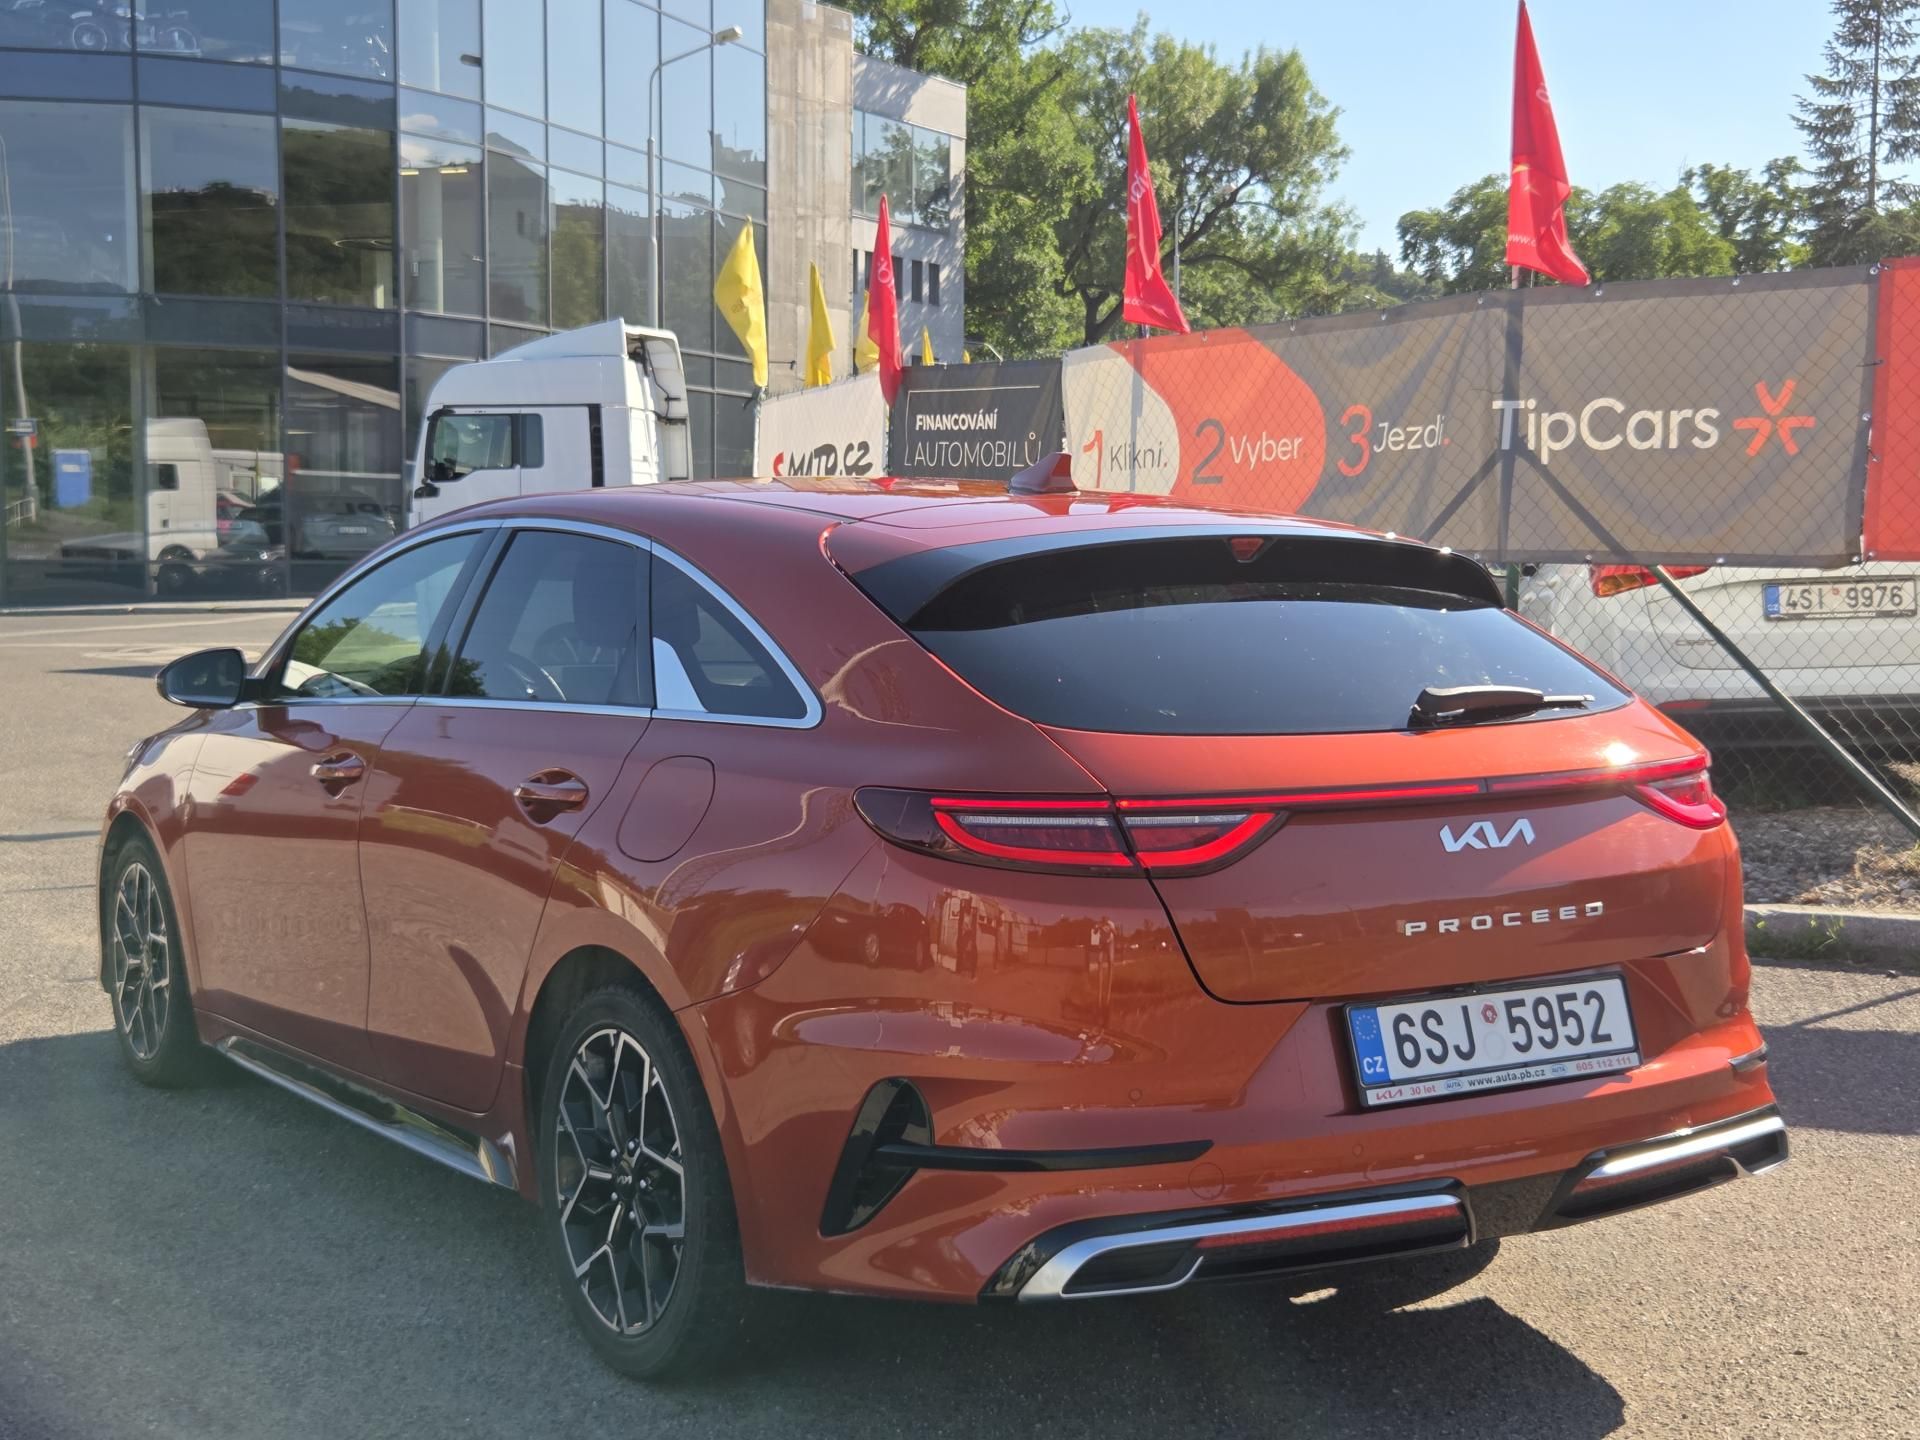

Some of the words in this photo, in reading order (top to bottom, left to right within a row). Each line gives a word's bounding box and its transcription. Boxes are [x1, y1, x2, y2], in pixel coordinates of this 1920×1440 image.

[915, 408, 998, 431] FINANCOVÁNÍ
[1491, 397, 1720, 465] TipCars
[914, 432, 1041, 467] AUTOMOBILŮ
[1191, 418, 1225, 484] 2
[1337, 404, 1373, 477] 3
[1083, 430, 1103, 488] 1
[1110, 441, 1168, 472] Klikni.
[1846, 585, 1903, 608] 9976
[1439, 818, 1536, 853] KIA
[1405, 901, 1603, 936] PROCEED
[1392, 1004, 1476, 1068] 6SJ
[1503, 990, 1612, 1053] 5952
[1362, 1056, 1385, 1074] CZ
[1410, 1086, 1421, 1096] 30
[1468, 1068, 1546, 1087] www.auta.pb.cz
[1576, 1062, 1593, 1072] 605
